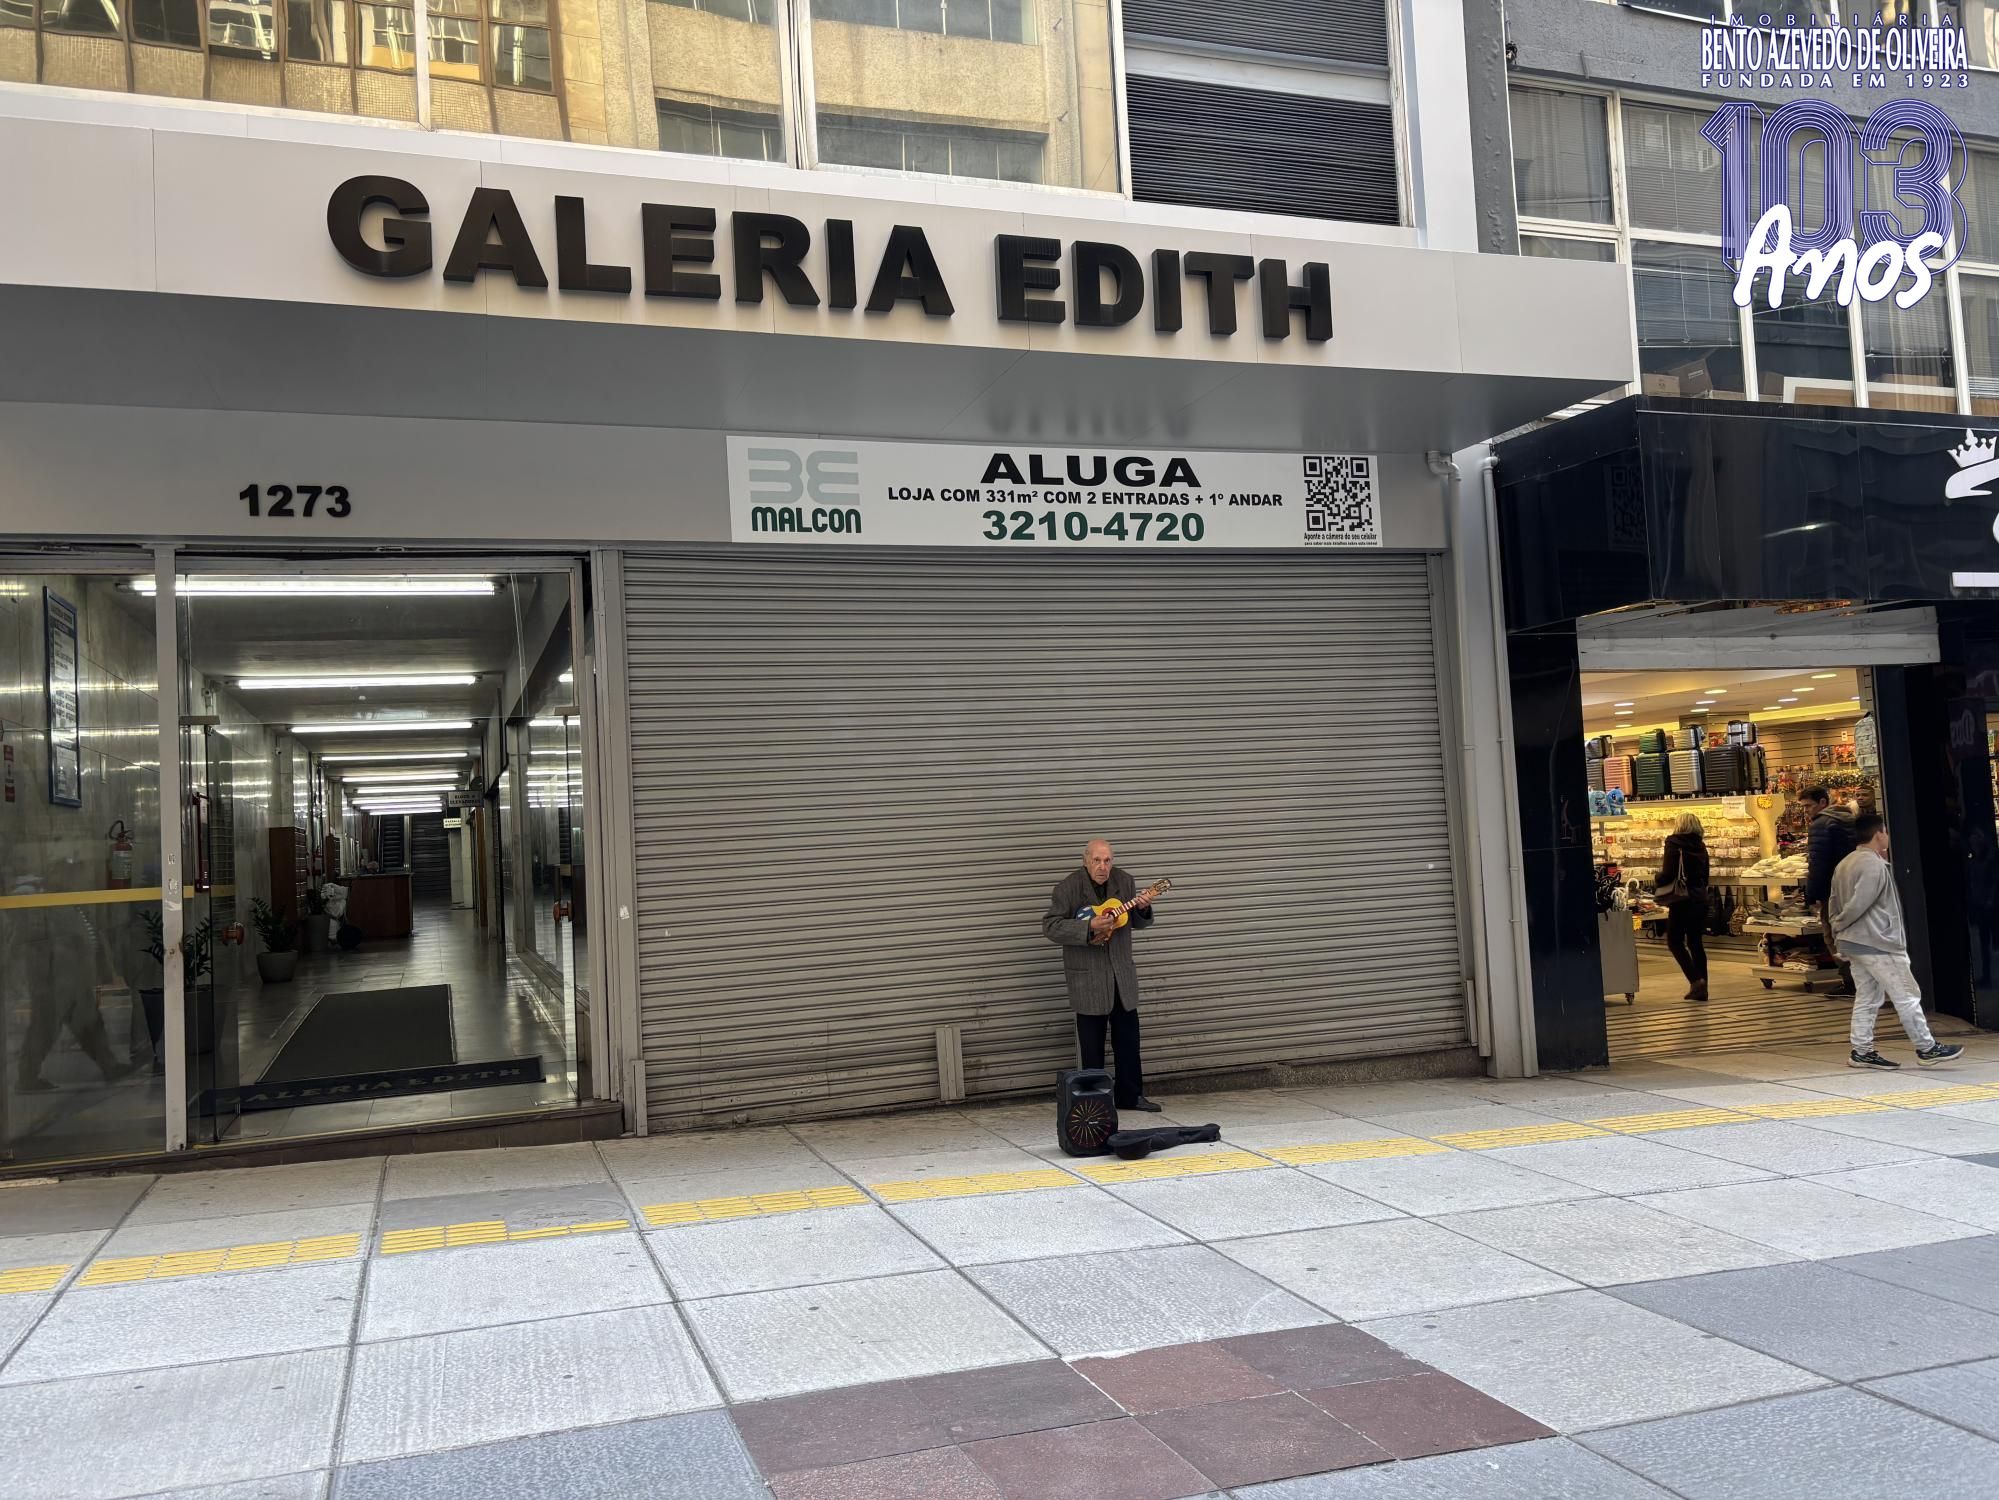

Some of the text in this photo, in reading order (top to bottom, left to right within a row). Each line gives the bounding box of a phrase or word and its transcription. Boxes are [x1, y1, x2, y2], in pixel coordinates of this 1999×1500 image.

[327, 174, 1333, 342] GALERIA EDITH
[980, 453, 1202, 488] ALUGA
[239, 483, 352, 519] 1273
[888, 486, 935, 502] LOJA
[940, 488, 981, 503] COM
[1043, 491, 1082, 505] COM
[1086, 492, 1097, 505] 2
[1101, 492, 1190, 506] ENTRADAS
[1195, 494, 1204, 505] +
[1228, 494, 1283, 507] ANDAR
[751, 506, 862, 534] MALCON
[982, 510, 1205, 542] 3210-4720
[1344, 532, 1351, 540] do
